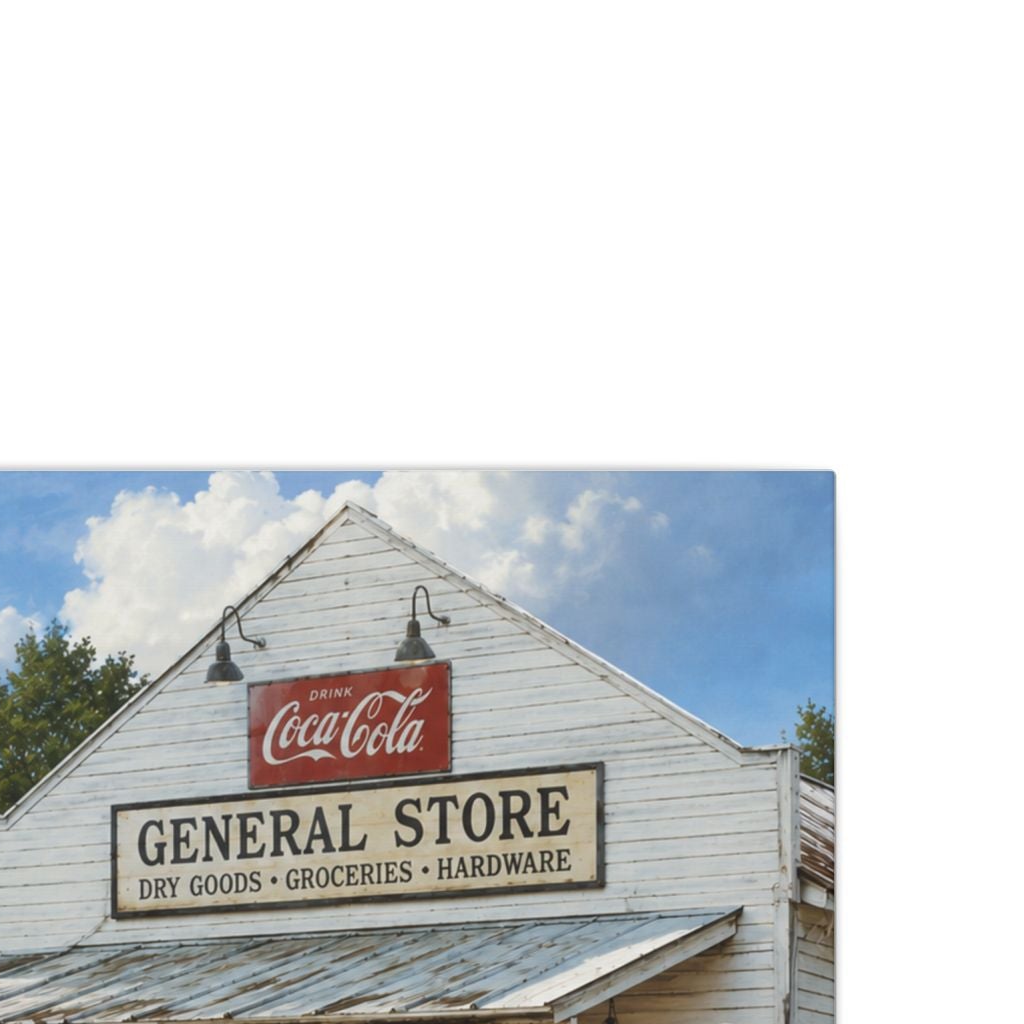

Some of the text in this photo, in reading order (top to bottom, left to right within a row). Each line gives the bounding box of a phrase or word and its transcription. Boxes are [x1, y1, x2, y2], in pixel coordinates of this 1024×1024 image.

[309, 685, 353, 701] DRINK
[262, 687, 433, 766] Coca-Cola
[137, 786, 571, 867] GENERAL STORE
[138, 849, 573, 900] DRY GOODS GROCERIES HARDWARE
